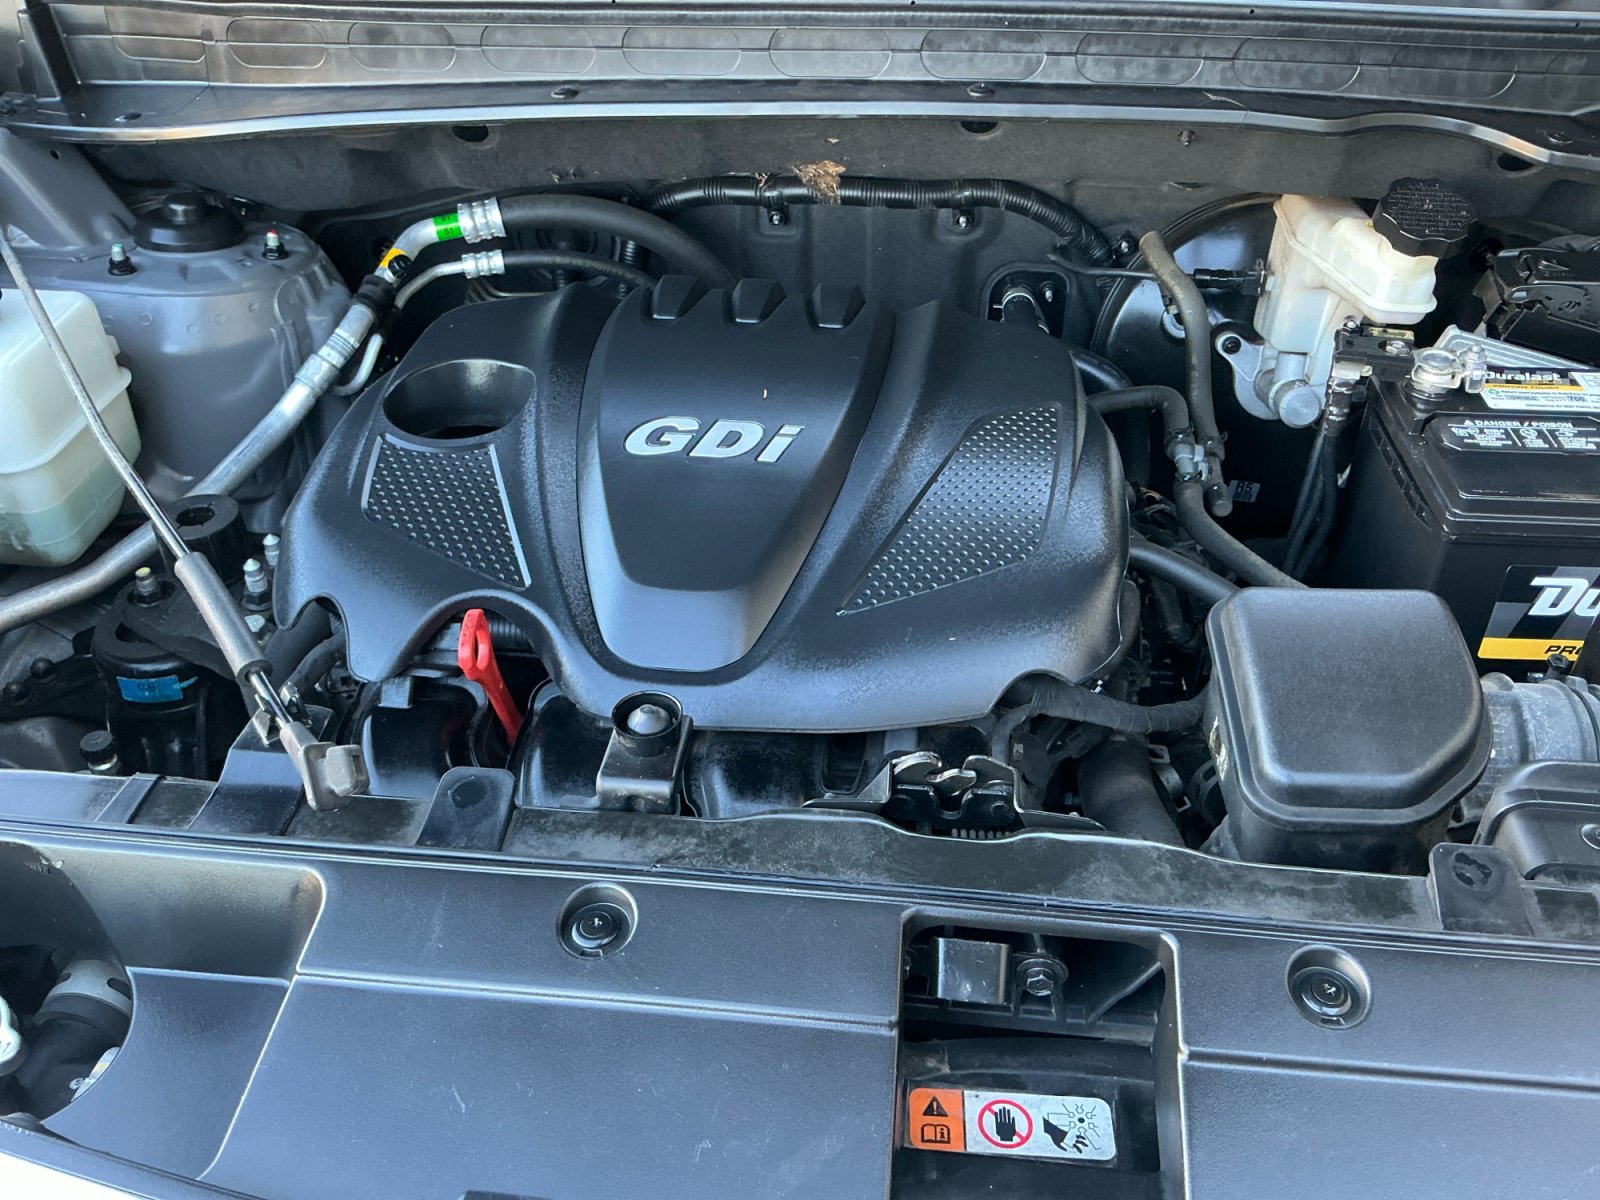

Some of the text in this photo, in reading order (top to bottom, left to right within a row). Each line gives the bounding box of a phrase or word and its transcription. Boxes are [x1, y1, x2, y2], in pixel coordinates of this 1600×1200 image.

[1485, 370, 1562, 381] Duralast
[1474, 420, 1521, 428] DANGER
[1532, 421, 1574, 429] POISON
[623, 416, 804, 463] GDi
